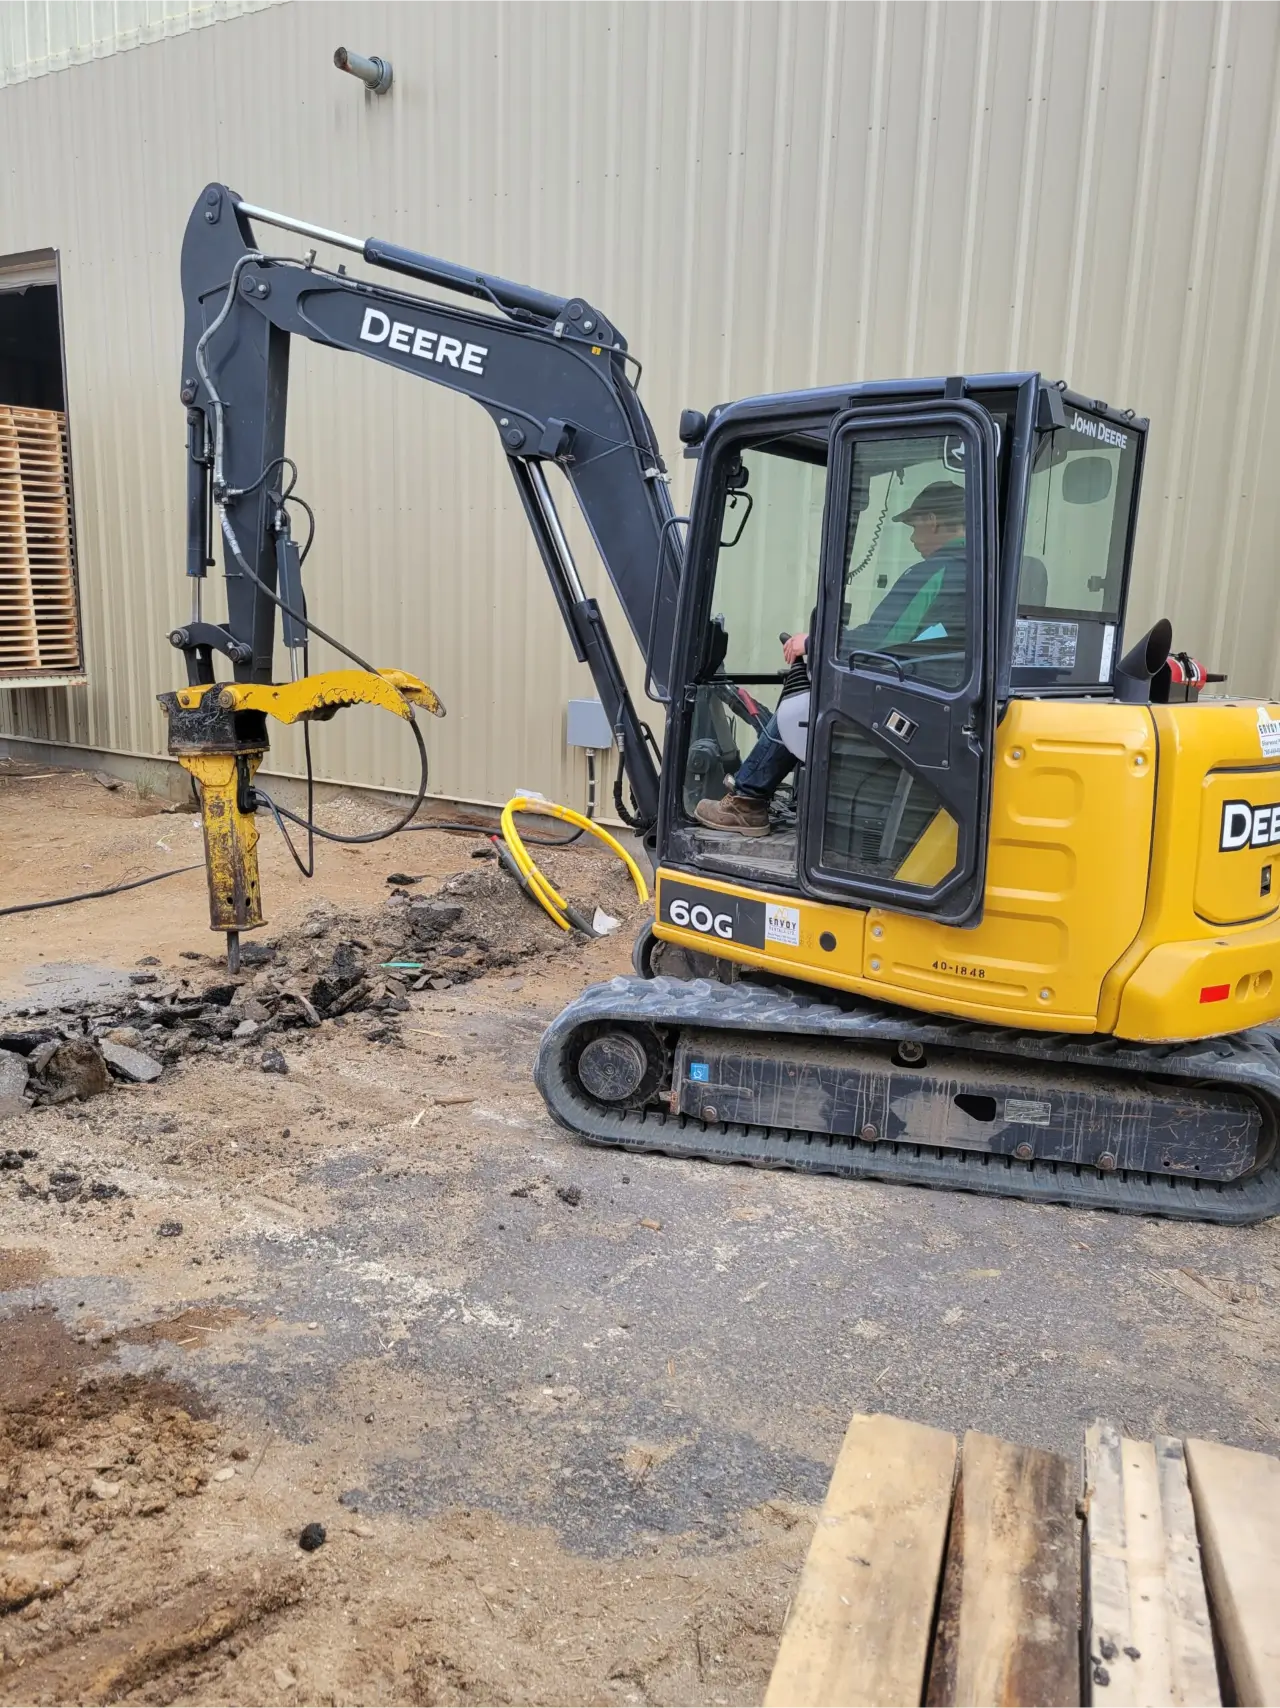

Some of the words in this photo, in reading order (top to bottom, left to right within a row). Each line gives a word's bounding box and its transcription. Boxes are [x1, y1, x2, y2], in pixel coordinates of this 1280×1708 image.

[360, 307, 488, 375] DEERE
[1070, 412, 1097, 438] JOHN
[1097, 422, 1128, 450] DEERE
[669, 899, 733, 939] 60G
[768, 917, 797, 930] ENVOY
[932, 960, 985, 978] 40-1848
